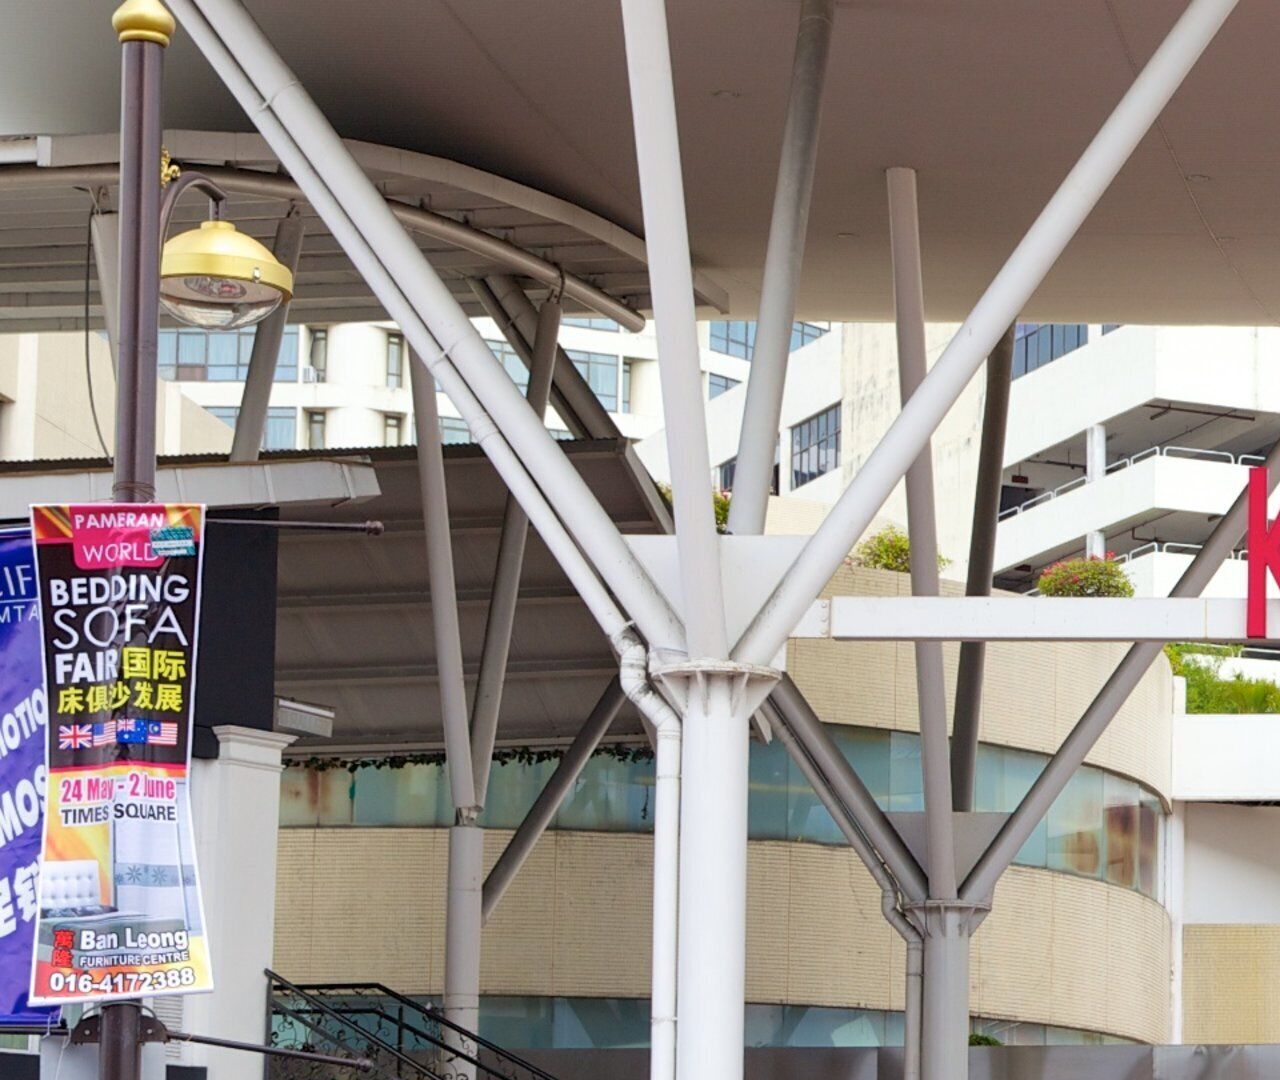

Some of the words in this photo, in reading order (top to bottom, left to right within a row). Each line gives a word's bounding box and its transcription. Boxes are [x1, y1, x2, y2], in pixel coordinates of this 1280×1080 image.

[74, 512, 165, 530] PAMERAN
[0, 564, 33, 597] IF
[50, 574, 190, 607] BEDDING
[53, 603, 189, 650] SOFA
[54, 649, 119, 685] FAIR
[122, 647, 187, 681] 国际
[56, 680, 184, 715] 床俱沙发展
[0, 685, 46, 760] OTIO
[61, 778, 83, 803] 24
[87, 777, 115, 802] May
[129, 773, 141, 798] 2
[143, 774, 176, 800] June
[61, 806, 110, 825] TIMES
[113, 803, 177, 822] SQUARE
[79, 929, 118, 951] Ban
[124, 927, 189, 951] Leong
[79, 954, 141, 968] FURNITURE
[142, 951, 190, 966] CENTRE
[50, 967, 195, 993] 016-4172388
